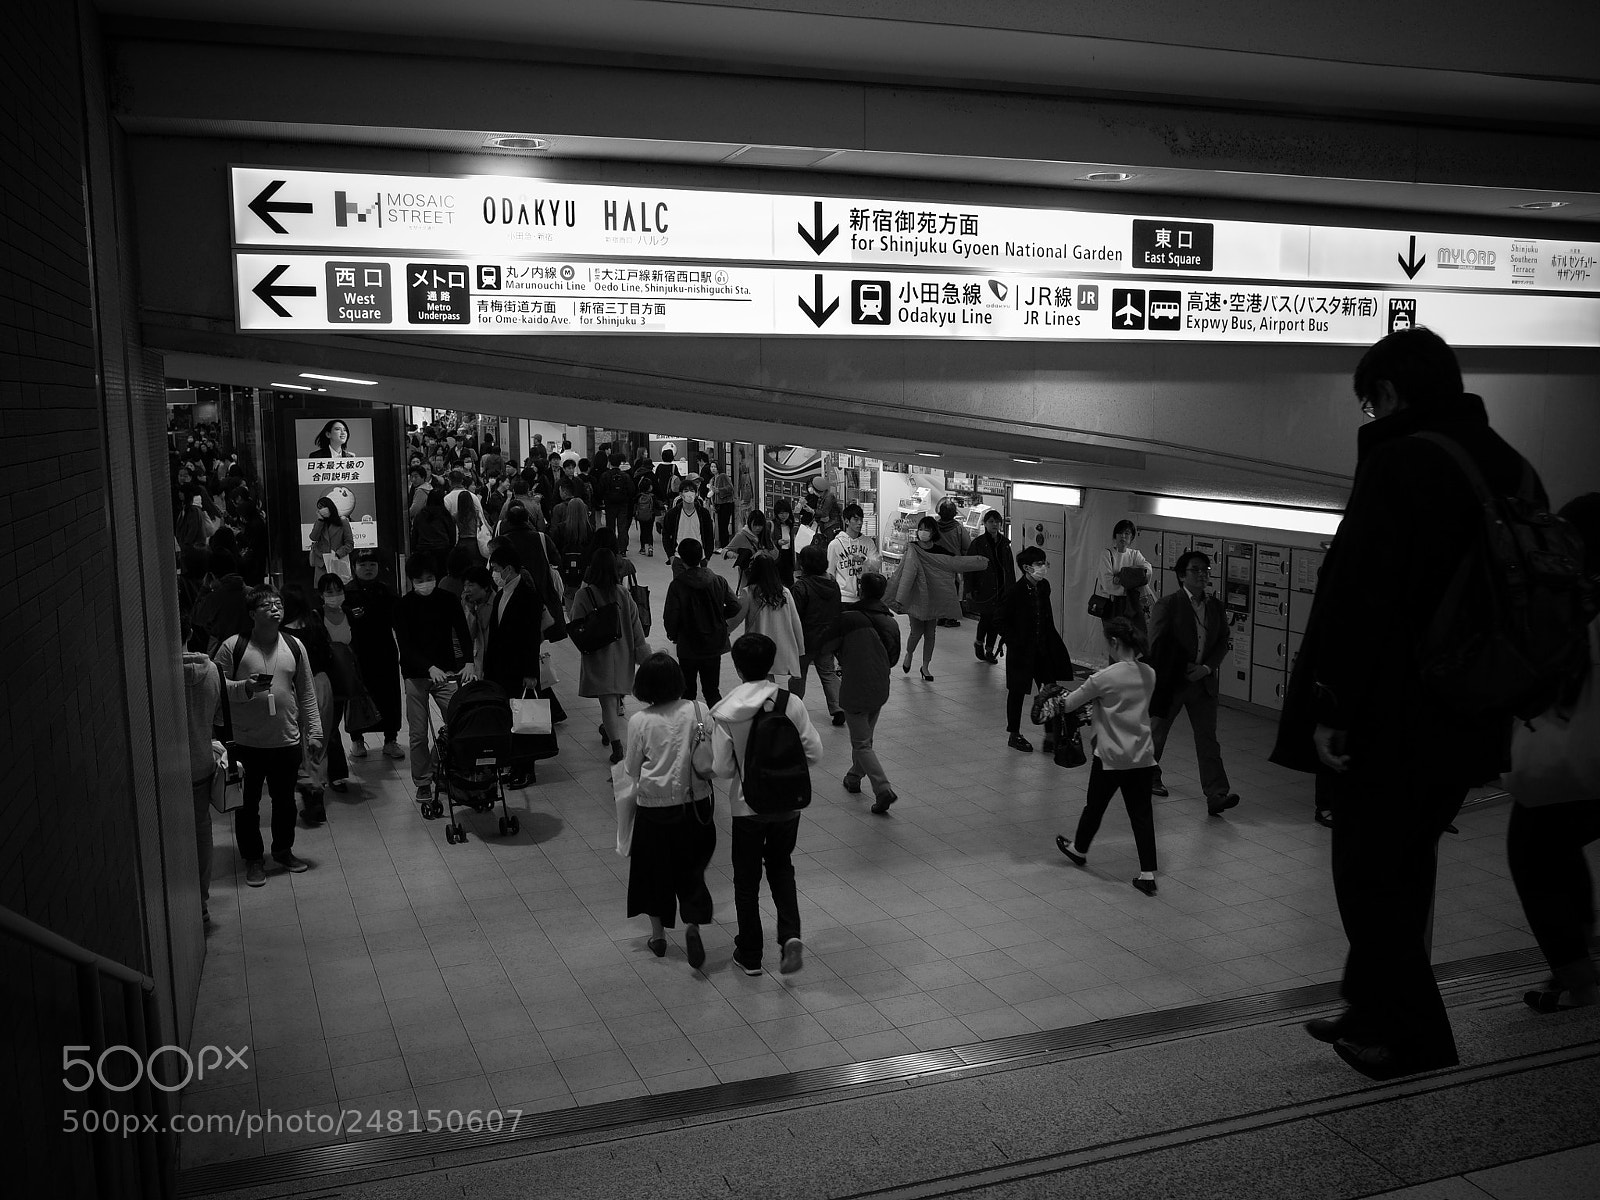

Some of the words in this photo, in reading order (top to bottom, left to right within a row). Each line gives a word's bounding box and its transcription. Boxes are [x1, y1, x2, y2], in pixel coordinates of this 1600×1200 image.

[387, 193, 455, 208] MOSAIC
[388, 209, 456, 224] STREET
[483, 196, 576, 228] ODAKYU
[604, 199, 669, 234] HALC
[849, 207, 979, 236] 新宿御苑方面
[637, 236, 669, 246] ハルク
[1155, 228, 1193, 249] 東口
[851, 234, 874, 251] for
[880, 236, 947, 257] Shinjuku
[952, 238, 999, 259] Gyoen
[1005, 241, 1067, 259] National
[1073, 244, 1123, 261] Garden
[1511, 244, 1539, 254] Shinjuku
[1144, 252, 1166, 264] East
[1168, 253, 1201, 266] Square
[1437, 247, 1497, 265] MYLORD
[1510, 254, 1538, 264] Southern
[506, 266, 557, 279] 丸ノ内線
[602, 268, 712, 283] 大江戸線新宿西口駅
[1512, 264, 1536, 274] Terrace
[334, 266, 383, 289] 西口
[412, 269, 465, 289] メトロ
[506, 280, 564, 291] Marunouchi
[566, 282, 586, 291] Line
[594, 282, 618, 292] Oedo
[644, 284, 734, 296] Shinjuku-nishiguchi
[735, 286, 752, 296] Sta.
[344, 292, 376, 306] West
[426, 291, 451, 302] 通路
[898, 282, 982, 306] 小田急線
[1024, 286, 1072, 308] JR線
[1080, 291, 1096, 305] JR
[426, 302, 452, 312] Metro
[477, 300, 557, 314] 青梅街道方面
[580, 301, 666, 316] 新宿三丁目方面
[1390, 300, 1415, 311] TAXI
[338, 306, 382, 322] Square
[418, 311, 461, 322] Underpass
[478, 314, 492, 324] for
[495, 314, 549, 325] Ome-kaido
[550, 315, 572, 325] Ave.
[898, 306, 957, 328] Odakyu
[962, 308, 992, 324] Line
[1023, 310, 1040, 326] JR
[1045, 310, 1081, 326] Lines
[580, 316, 594, 326] for
[596, 315, 638, 328] Shinjuku
[640, 316, 646, 326] 3
[1186, 316, 1228, 333] Expwy
[1231, 316, 1256, 332] Bus,
[1260, 317, 1305, 334] Airport
[1308, 318, 1329, 332] Bus
[307, 460, 364, 470] 日本最大級の
[312, 472, 360, 482] 合同説明会
